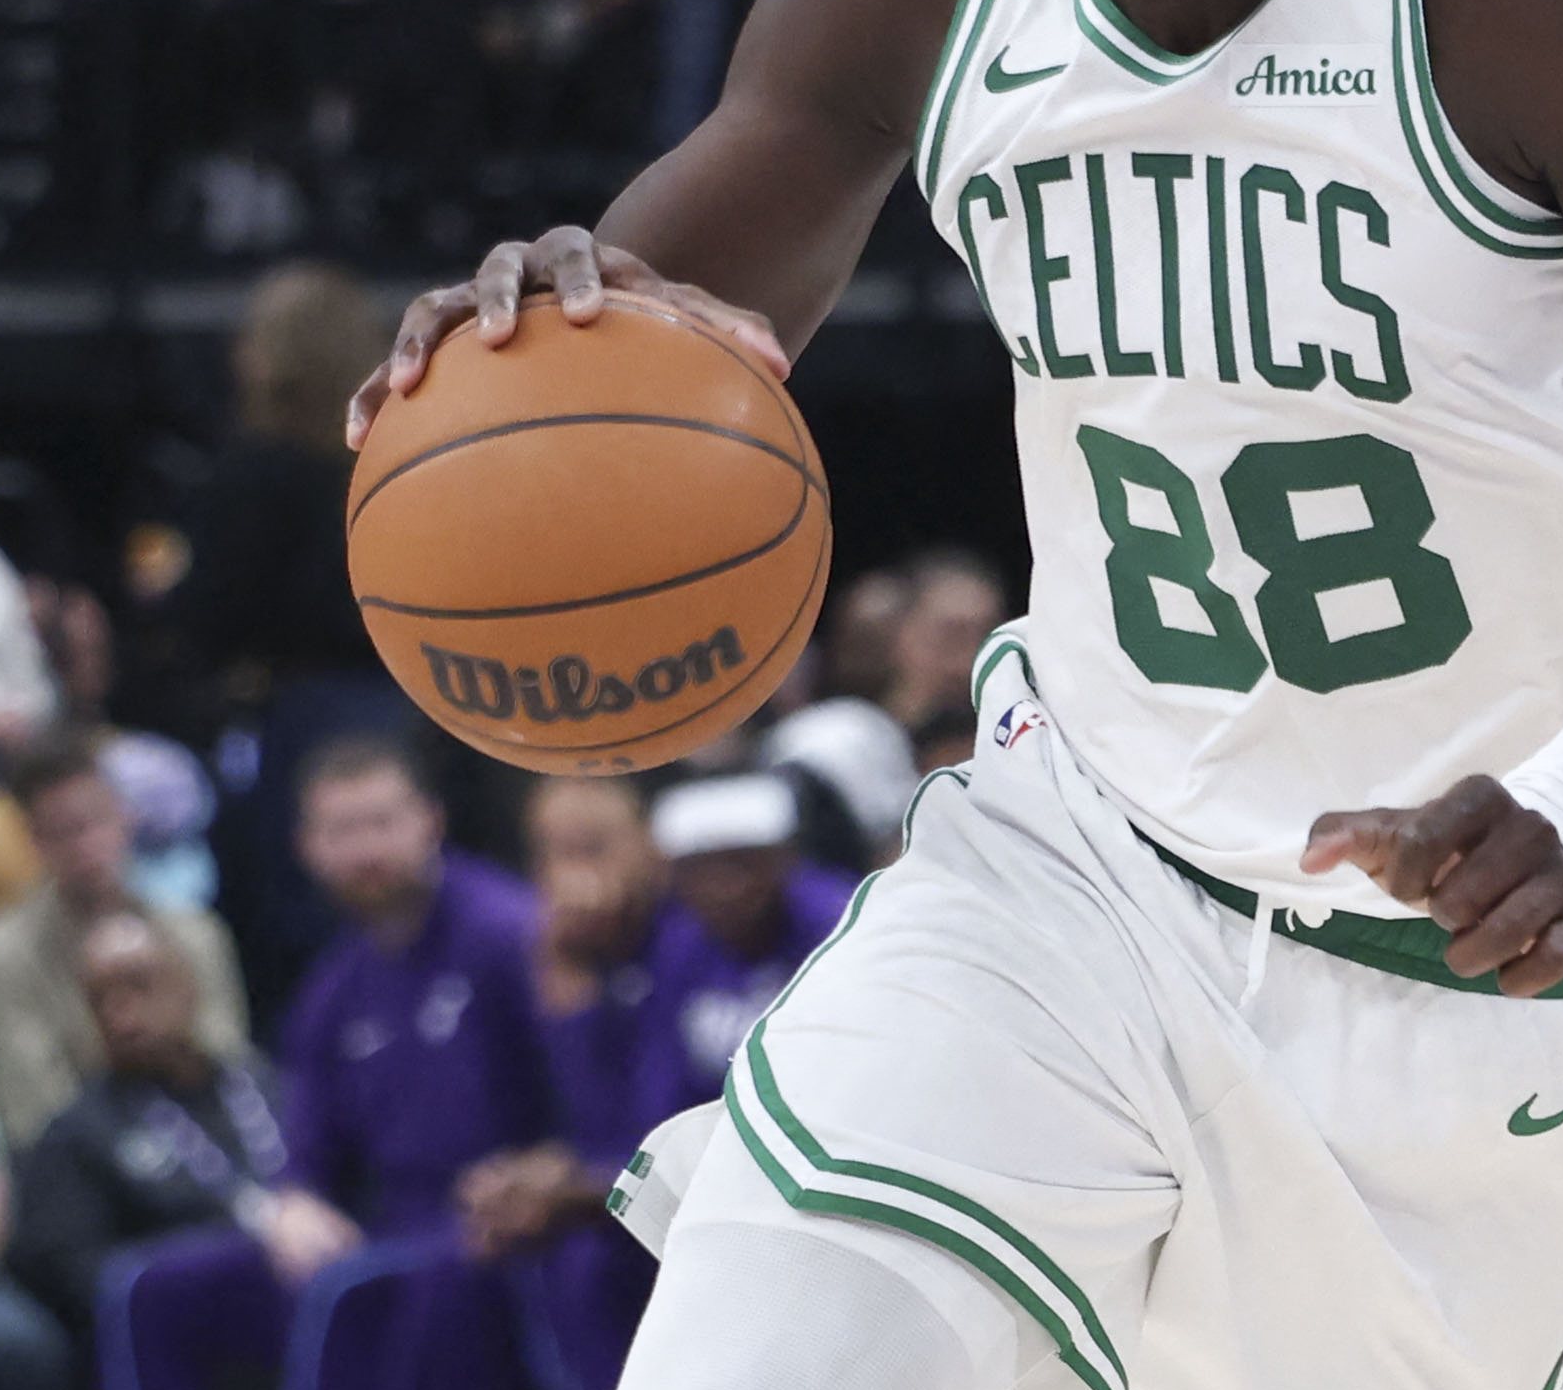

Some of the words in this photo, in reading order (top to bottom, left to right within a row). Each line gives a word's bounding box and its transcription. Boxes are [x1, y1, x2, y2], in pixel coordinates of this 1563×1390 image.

[1235, 54, 1377, 96] Amica
[956, 152, 1413, 403] CELTICS
[1077, 423, 1474, 694] 88
[420, 624, 749, 724] Wilson
